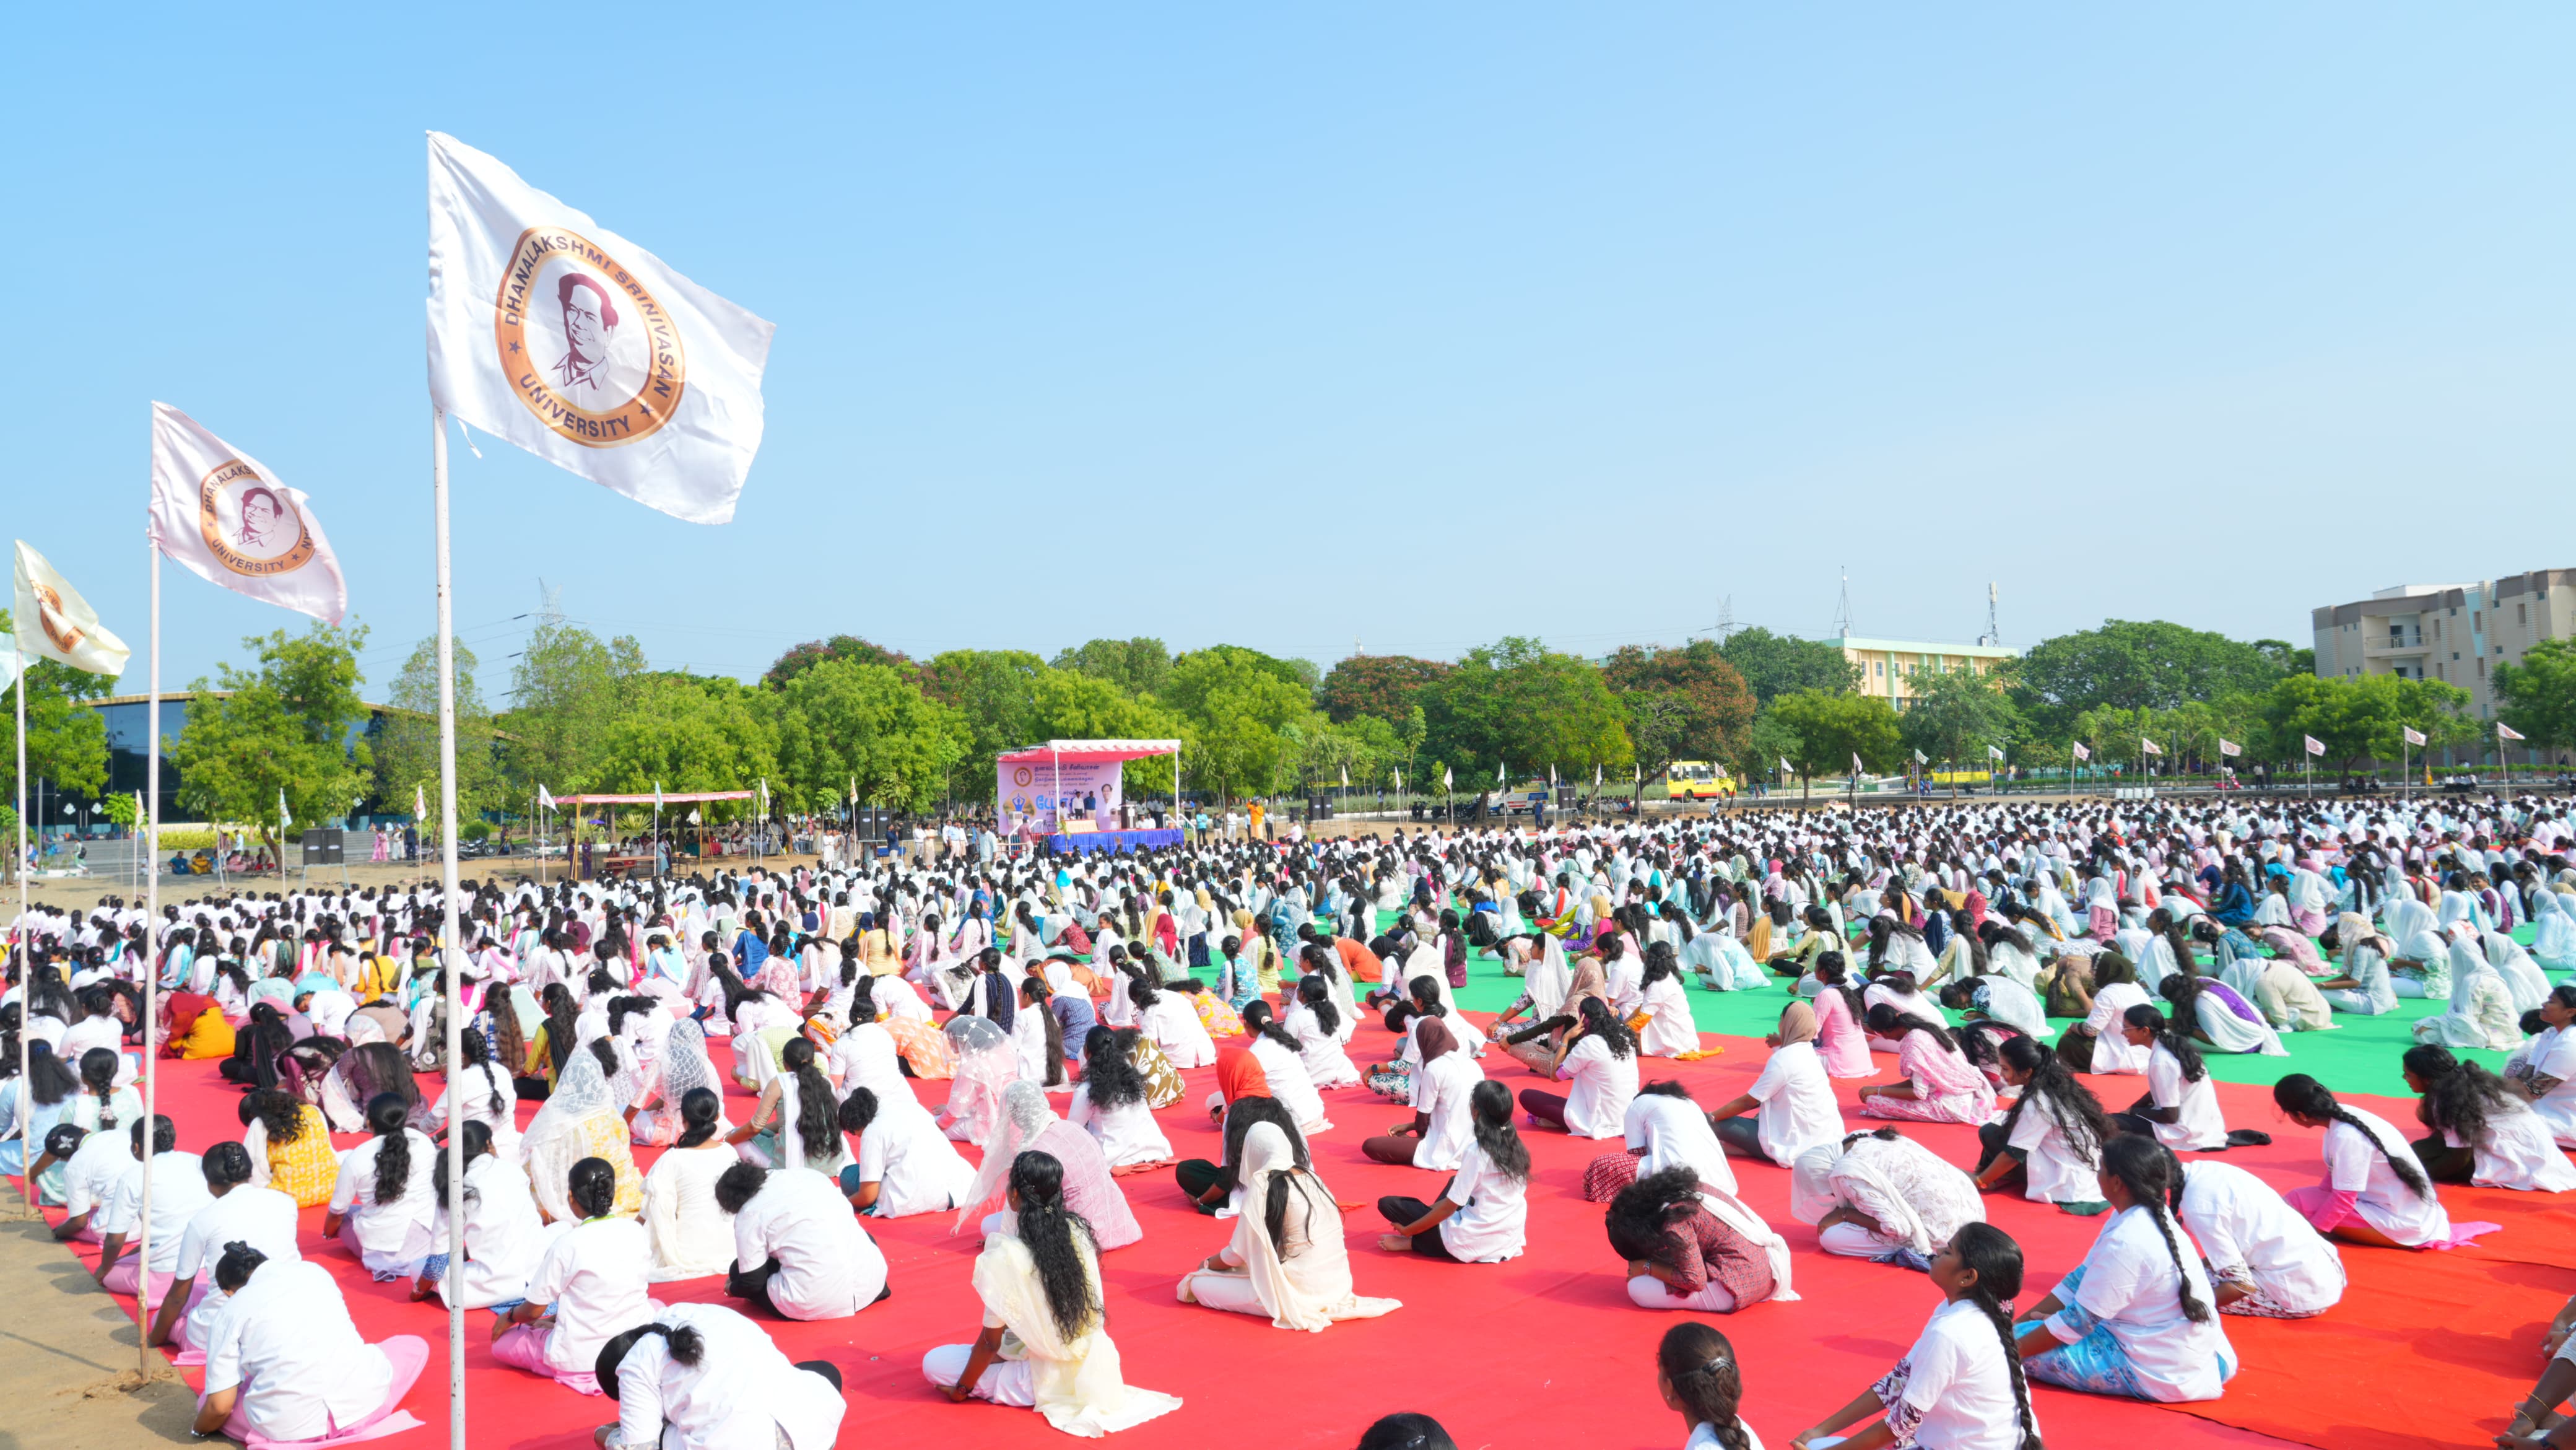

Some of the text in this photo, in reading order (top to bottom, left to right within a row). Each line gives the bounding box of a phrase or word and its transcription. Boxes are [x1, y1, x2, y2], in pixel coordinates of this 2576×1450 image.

[505, 235, 674, 398] DHANALAKSHMI SRINIVASAN
[520, 373, 630, 437] UNIVERSITY
[204, 465, 255, 513] DHANALAKS
[212, 538, 284, 572] UNIVERSITY
